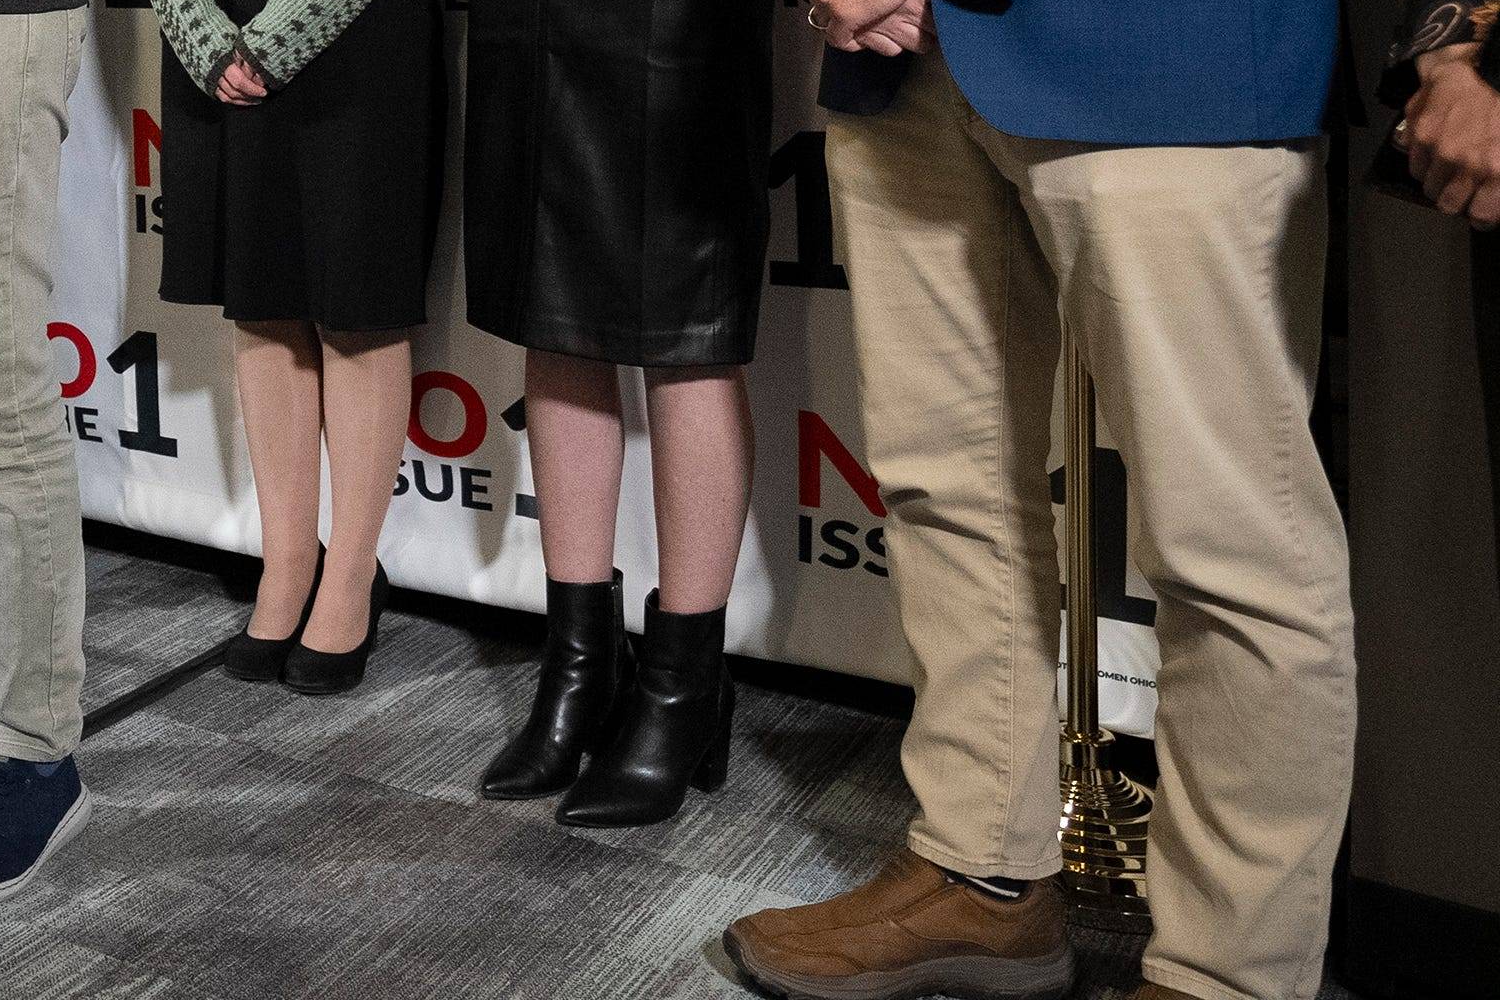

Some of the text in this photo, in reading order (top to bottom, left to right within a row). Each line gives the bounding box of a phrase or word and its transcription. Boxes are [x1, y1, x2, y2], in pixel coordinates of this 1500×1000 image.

[47, 322, 178, 458] O 1
[407, 371, 487, 458] O
[799, 515, 889, 577] ISS
[1098, 670, 1157, 689] OMEN OHIO
